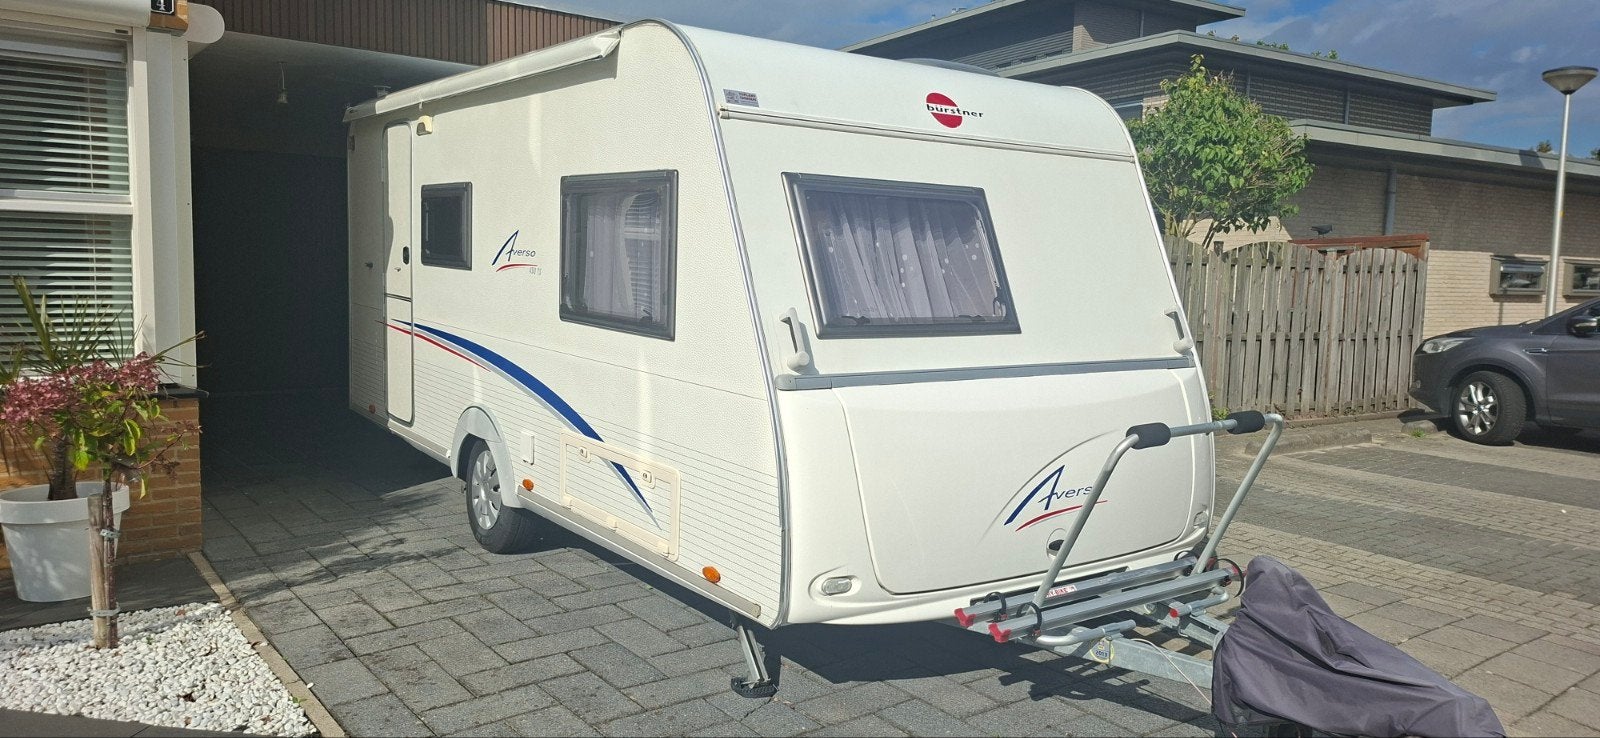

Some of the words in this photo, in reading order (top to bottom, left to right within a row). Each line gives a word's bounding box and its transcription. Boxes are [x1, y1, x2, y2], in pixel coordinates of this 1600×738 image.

[156, 0, 166, 11] 4
[926, 103, 984, 118] bürstner
[491, 229, 536, 265] Averso
[1003, 464, 1093, 526] Avers
